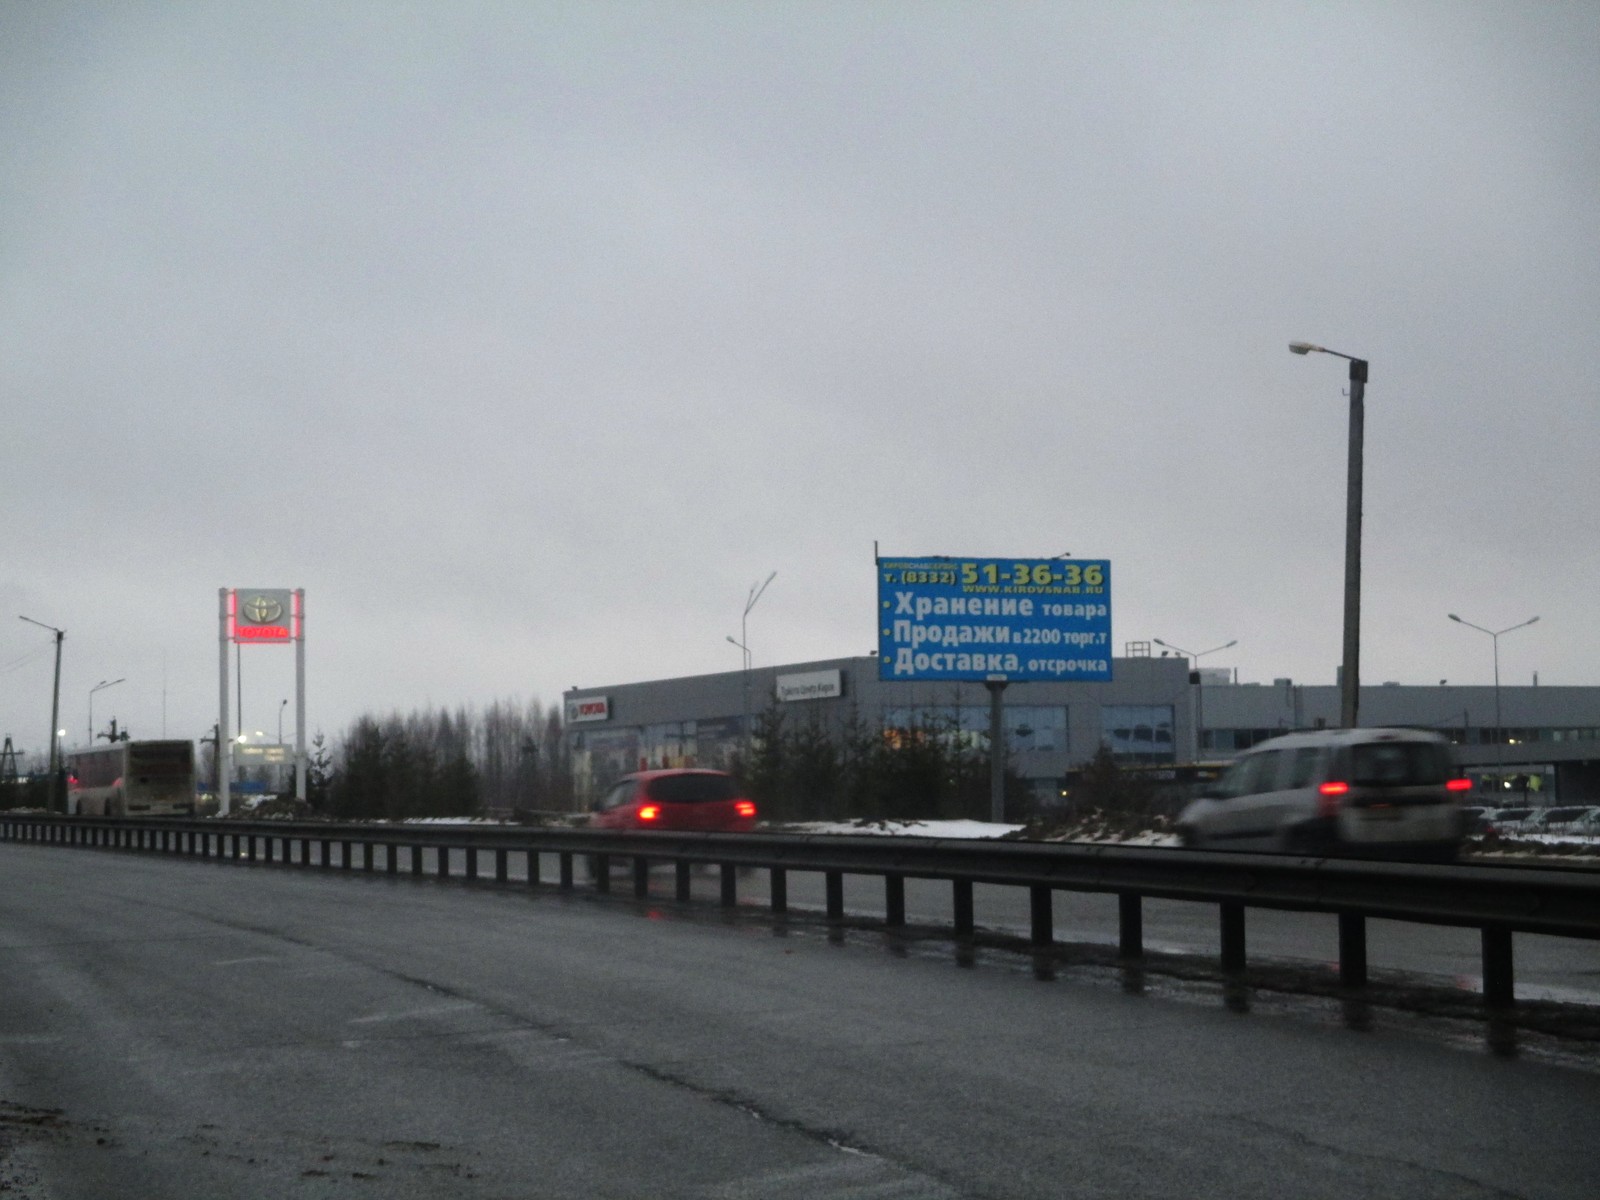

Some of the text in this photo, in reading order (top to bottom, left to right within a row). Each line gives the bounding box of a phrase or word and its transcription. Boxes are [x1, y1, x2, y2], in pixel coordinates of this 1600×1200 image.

[884, 562, 1105, 586] т. (8332) 51-36-36
[894, 591, 1107, 621] Хранение товара
[893, 619, 1010, 648] Продажи
[1023, 628, 1061, 644] 2200
[894, 647, 1108, 675] Доставка, отсрочка
